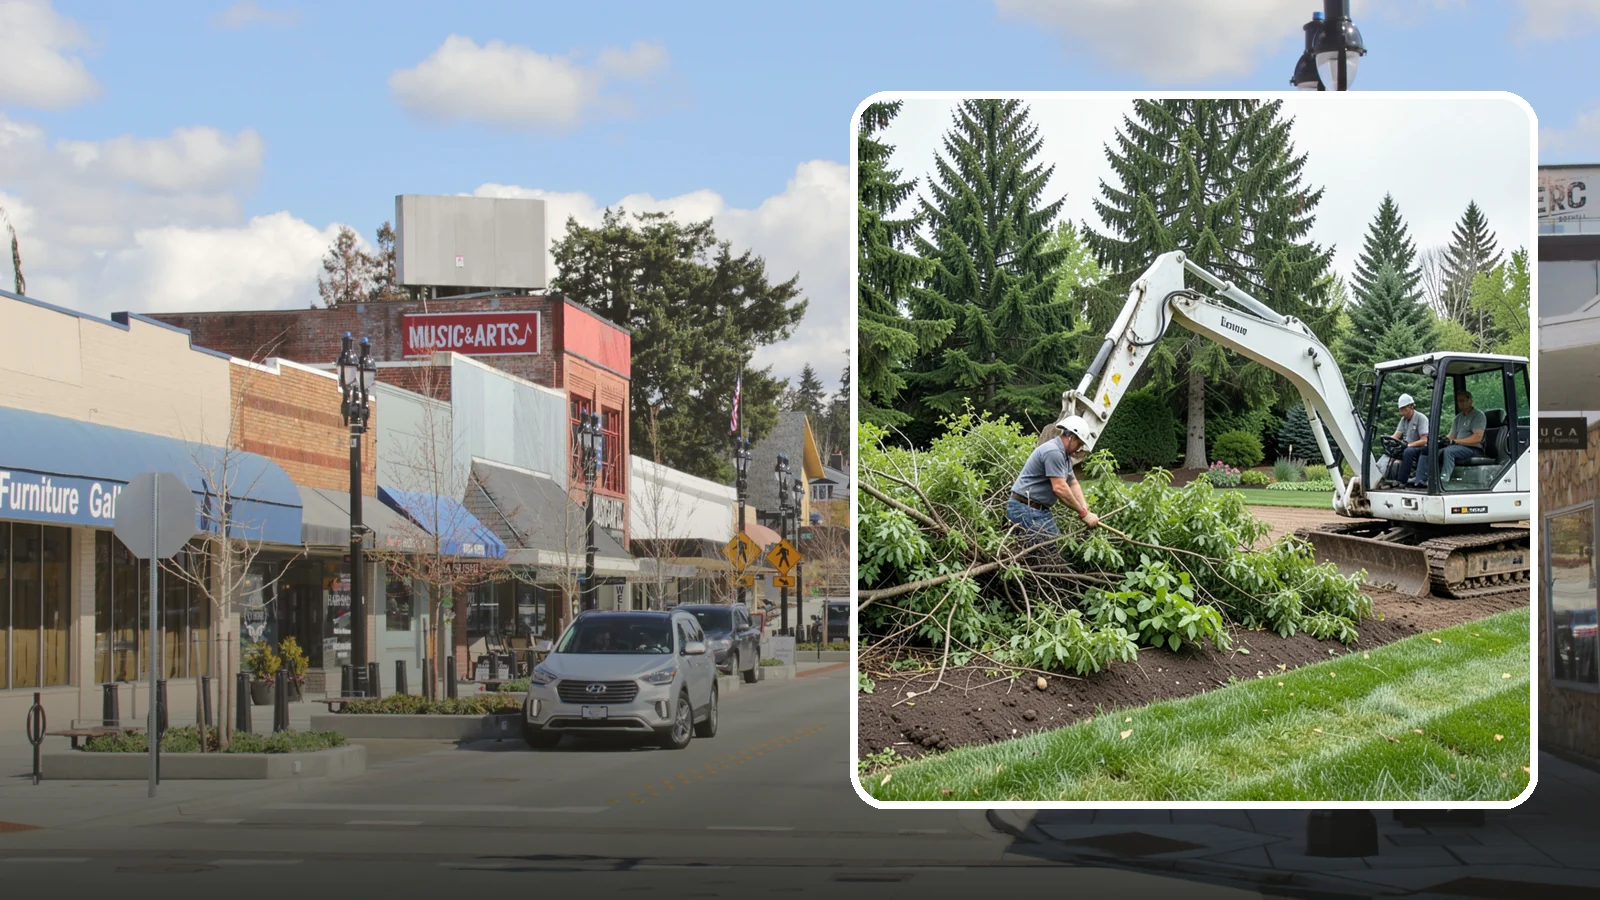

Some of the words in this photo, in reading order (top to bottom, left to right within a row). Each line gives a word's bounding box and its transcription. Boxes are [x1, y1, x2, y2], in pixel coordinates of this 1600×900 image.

[408, 323, 520, 349] MUSIC&ARTS
[0, 471, 79, 515] Furniture
[89, 482, 122, 519] Gal
